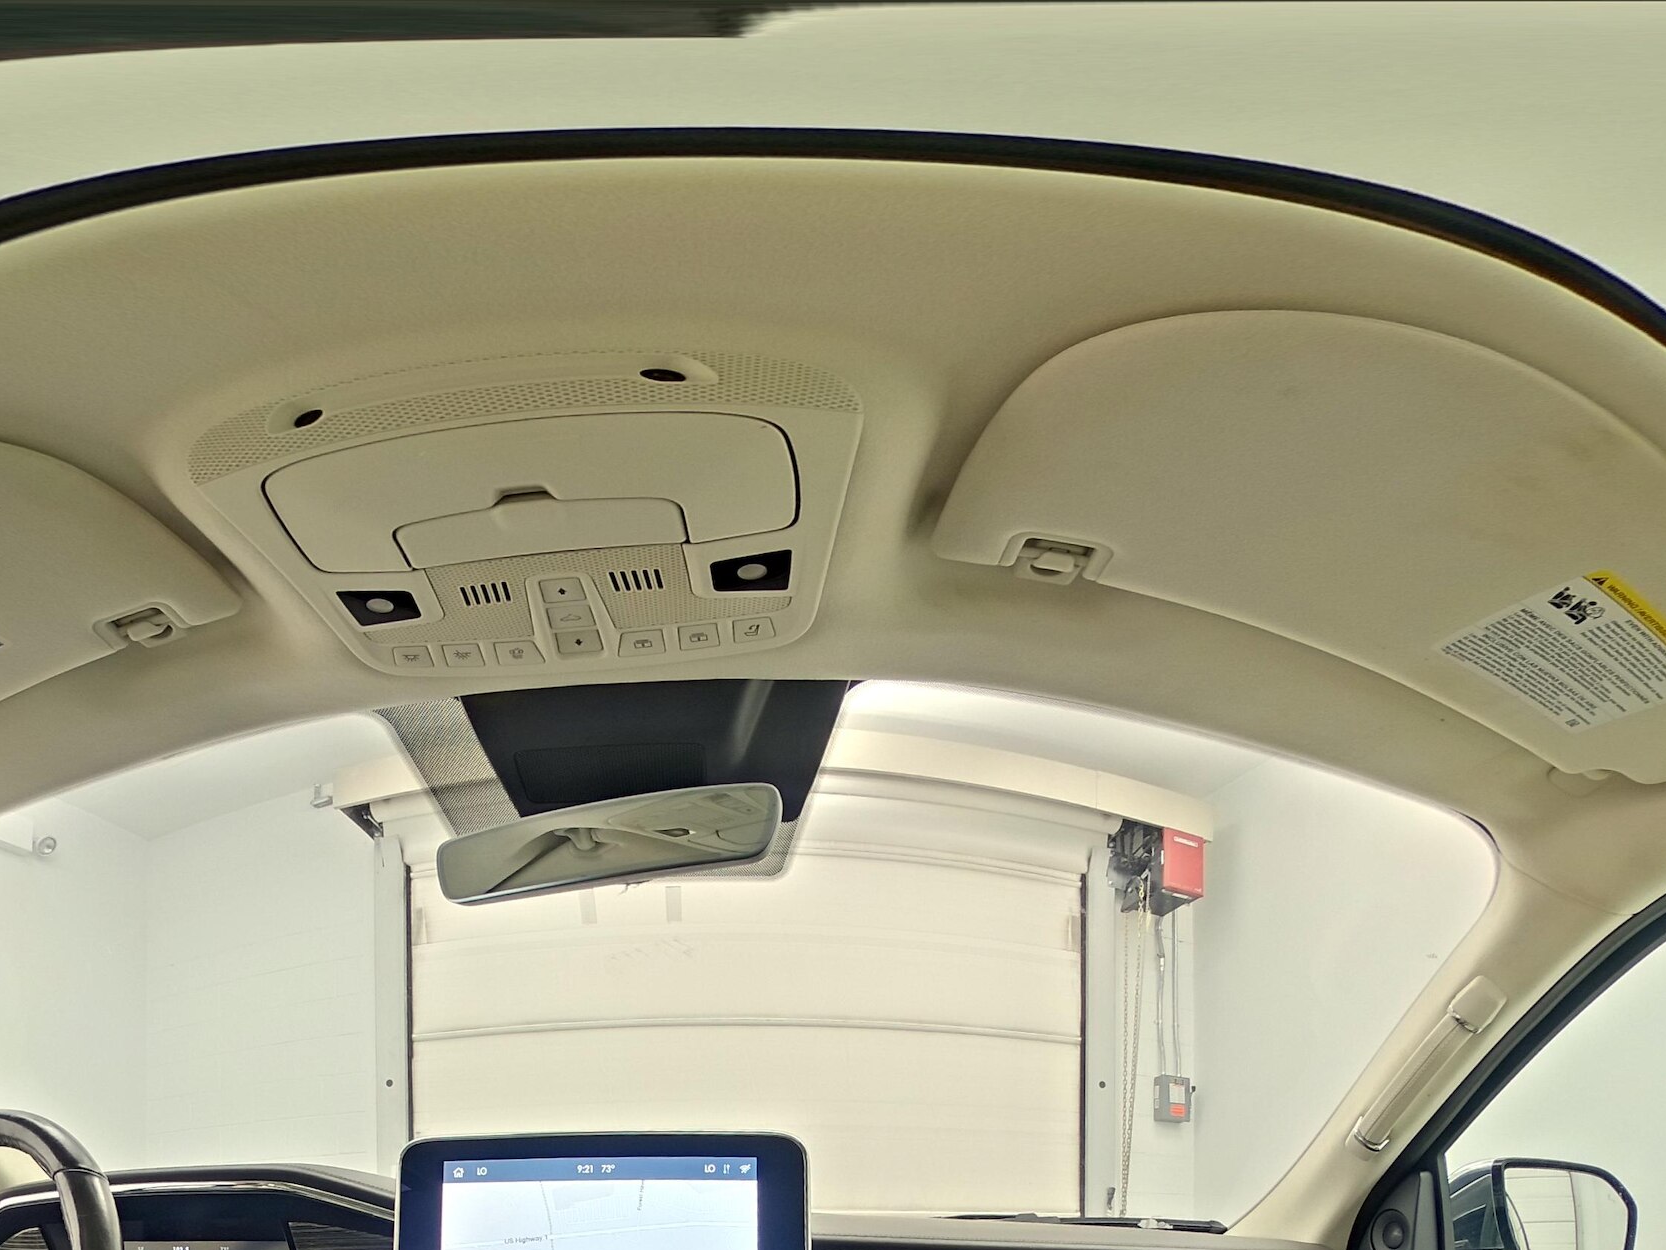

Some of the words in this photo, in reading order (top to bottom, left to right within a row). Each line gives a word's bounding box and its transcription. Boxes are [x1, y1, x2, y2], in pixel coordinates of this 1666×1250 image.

[1607, 584, 1638, 609] WARNING
[476, 1167, 487, 1176] LO
[576, 1164, 594, 1174] 9:21
[601, 1164, 615, 1173] 73°
[704, 1164, 716, 1173] LO
[515, 1236, 543, 1244] Highway
